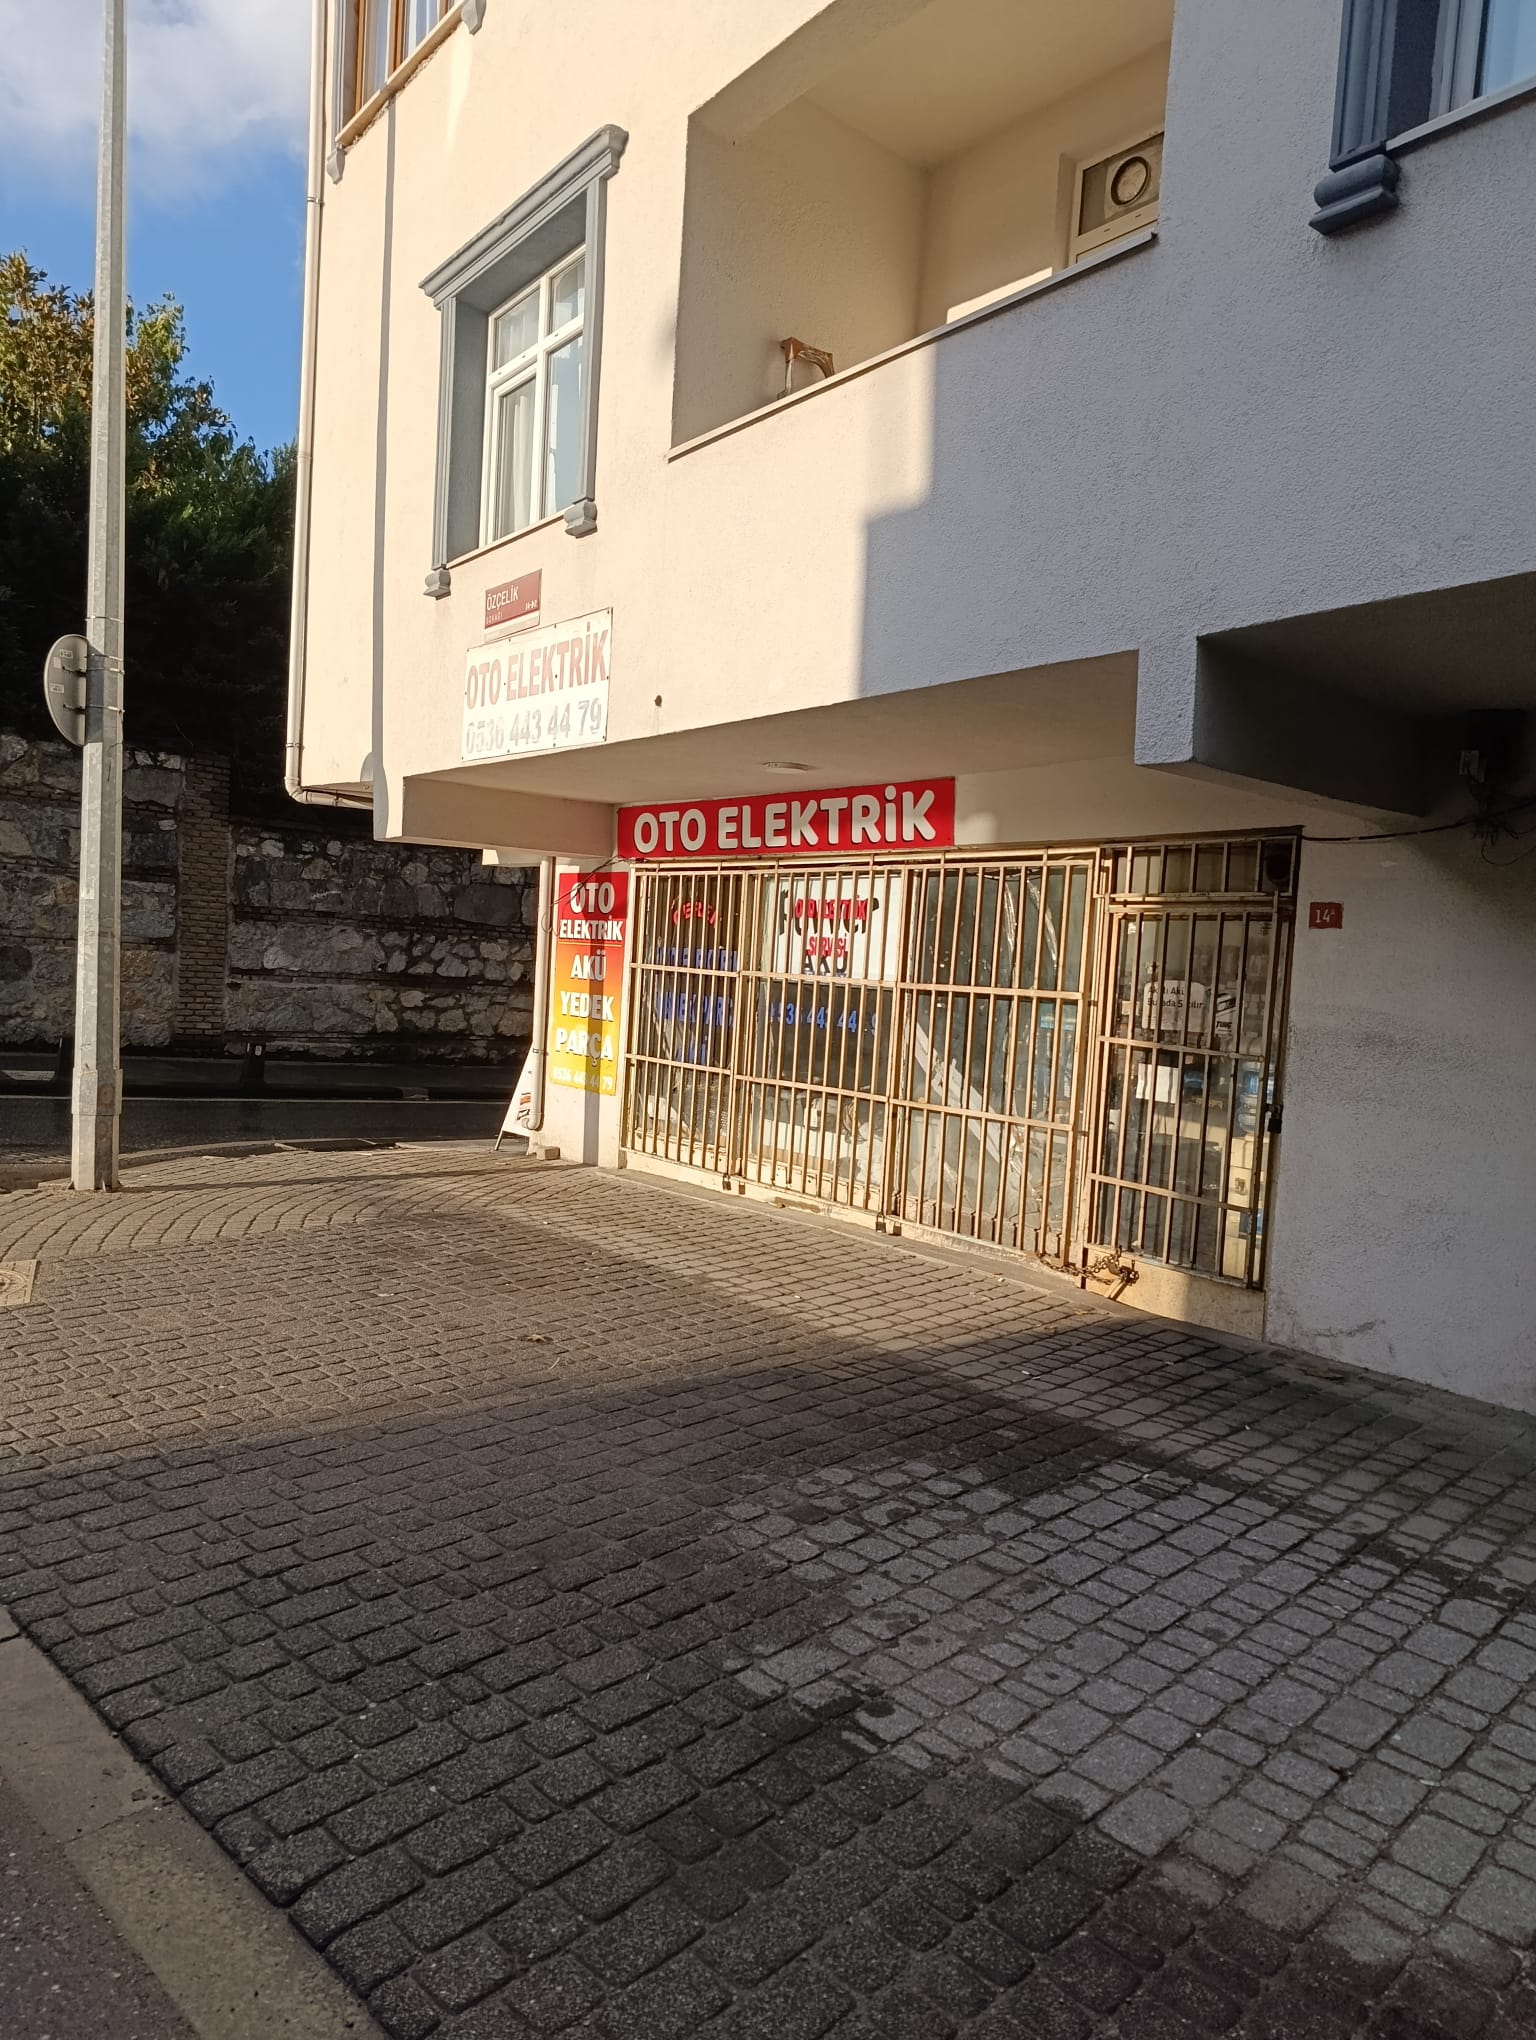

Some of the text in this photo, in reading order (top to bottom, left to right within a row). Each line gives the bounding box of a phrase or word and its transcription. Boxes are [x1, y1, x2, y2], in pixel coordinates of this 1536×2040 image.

[487, 585, 519, 611] ÖZÇELİK
[467, 621, 609, 710] OTO ELEKTRİK
[510, 709, 542, 746] 443
[547, 702, 571, 739] 44
[578, 697, 602, 736] 79
[633, 785, 937, 854] OTO ELEKTRİK
[570, 881, 615, 914] OTO
[559, 914, 624, 941] ELEKTRİK
[570, 949, 607, 981] AKÜ
[560, 990, 614, 1022] YEDEK
[555, 1027, 614, 1066] PARÇA
